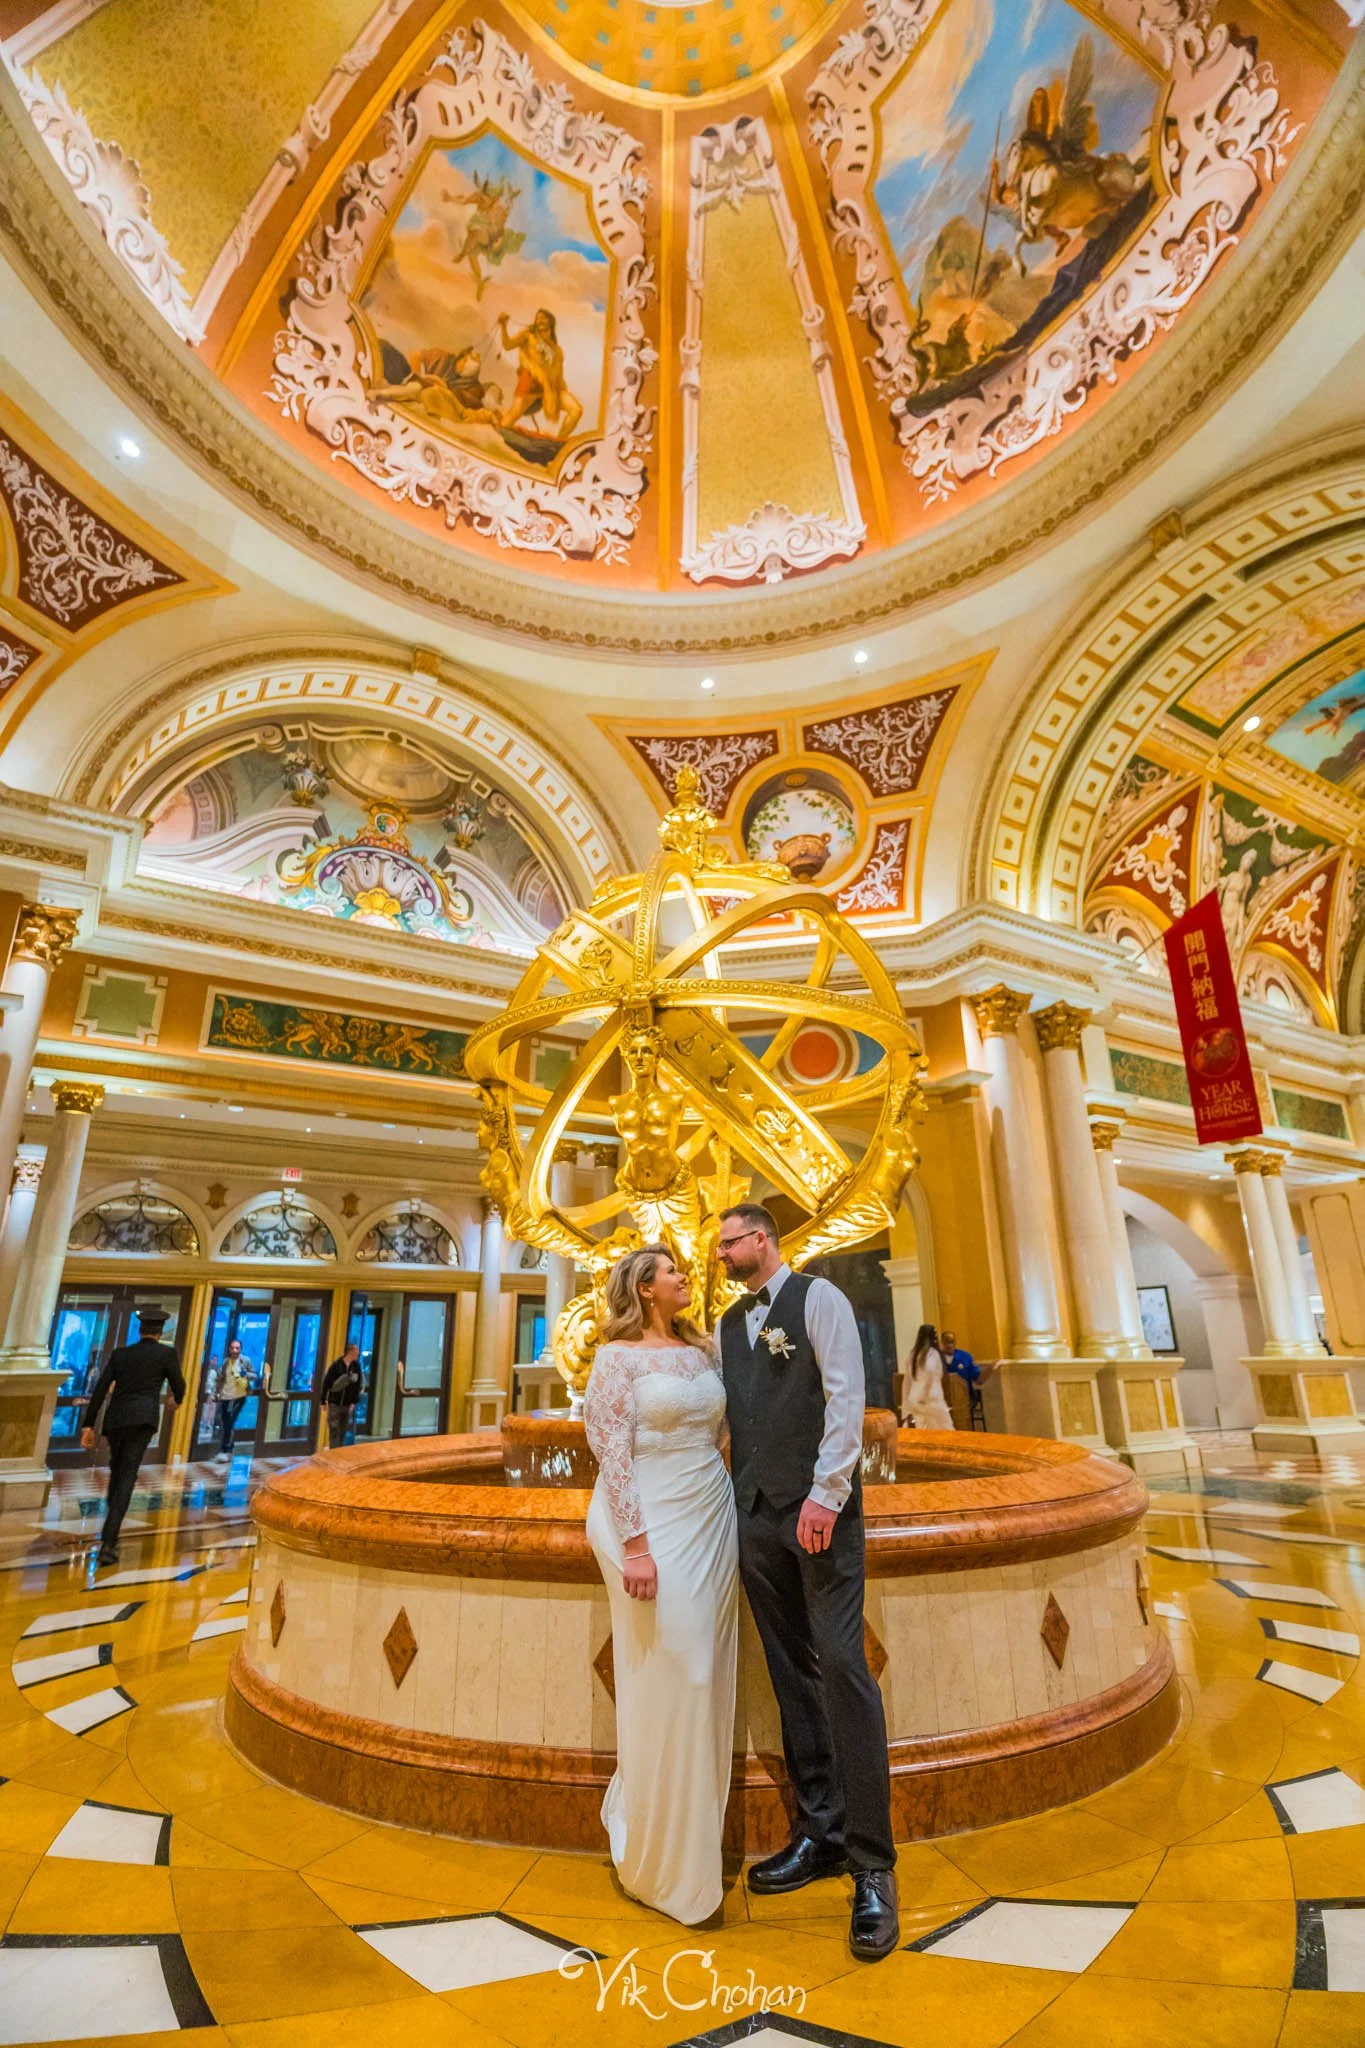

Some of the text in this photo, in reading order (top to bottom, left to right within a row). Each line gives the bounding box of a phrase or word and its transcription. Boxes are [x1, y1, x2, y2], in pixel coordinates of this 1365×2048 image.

[1184, 929, 1219, 1022] 開門納福
[1200, 1080, 1244, 1101] YEAR
[1198, 1098, 1255, 1121] HORSE
